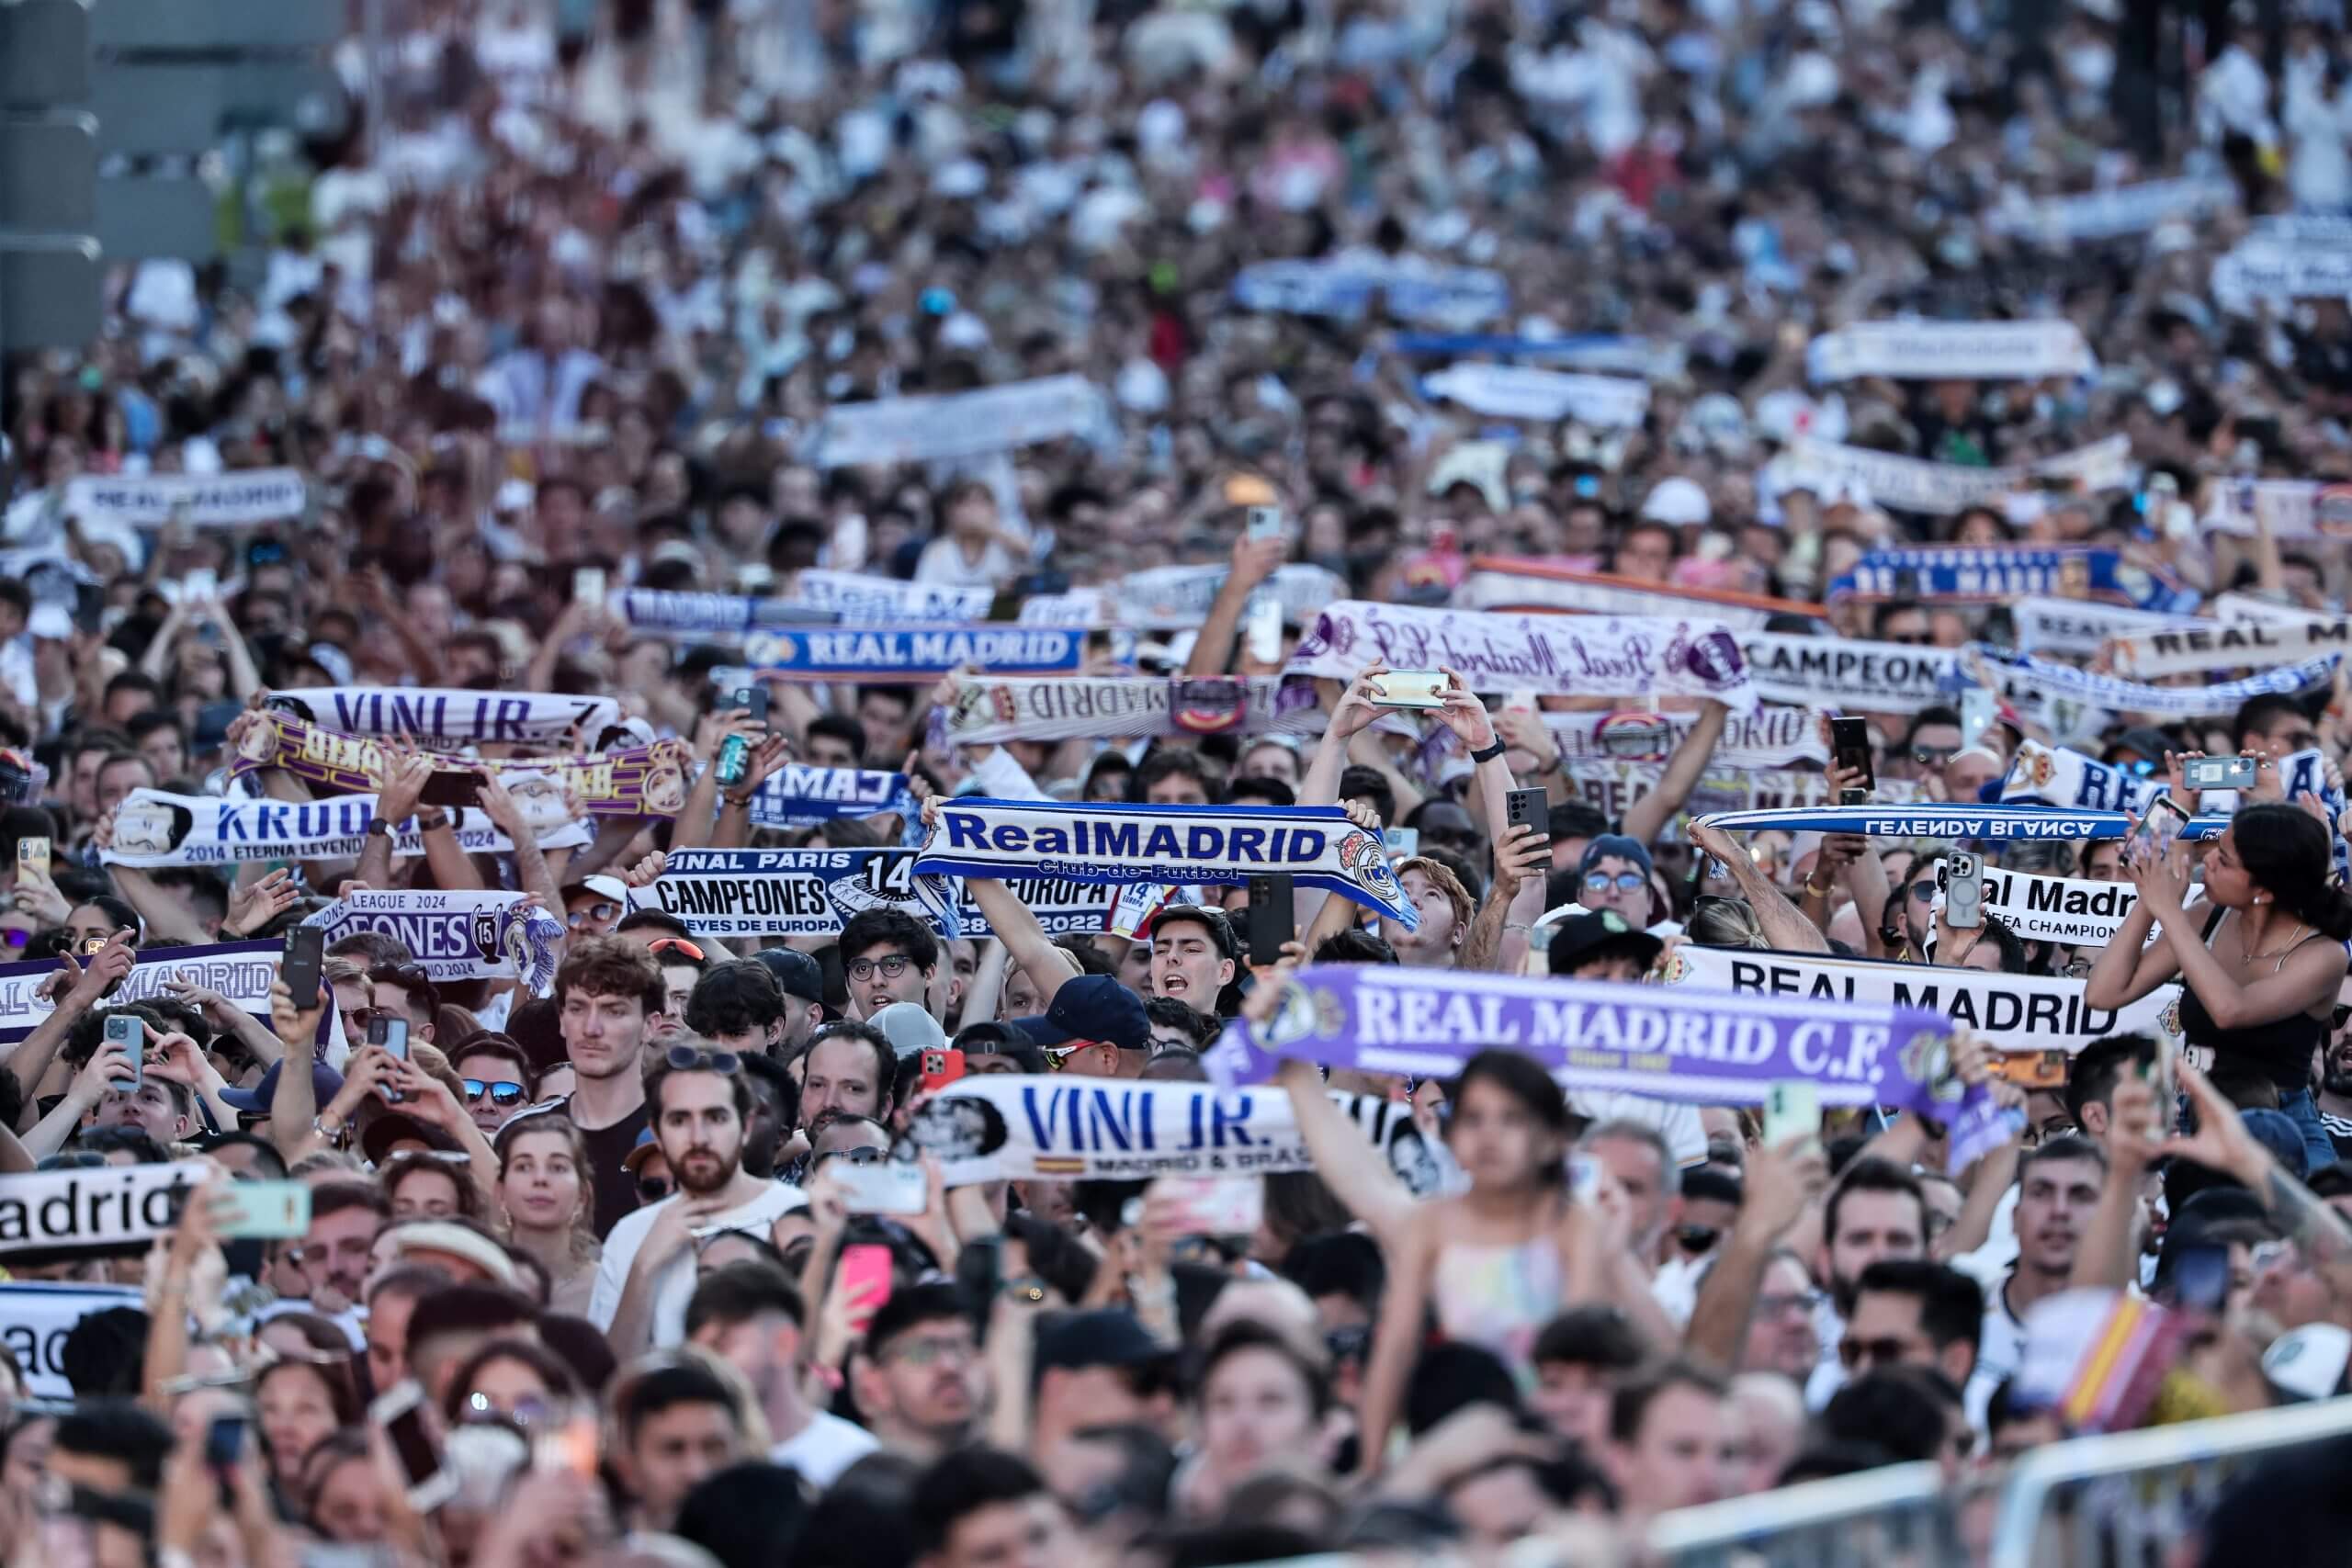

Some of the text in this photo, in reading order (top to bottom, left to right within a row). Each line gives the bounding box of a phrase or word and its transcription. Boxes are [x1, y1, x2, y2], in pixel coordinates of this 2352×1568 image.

[809, 632, 1070, 667] REAL MADRID
[2151, 627, 2278, 655] REAL
[334, 694, 447, 736] VINI
[473, 698, 540, 739] JR.
[1028, 684, 1169, 721] MADRID
[2074, 761, 2143, 814] RE
[186, 844, 226, 862] 2014
[234, 840, 296, 860] ETERNA
[300, 838, 363, 855] LEYEND
[944, 812, 1326, 863] RealMADRID
[758, 852, 852, 869] PARIS
[866, 854, 913, 894] 14
[1037, 859, 1239, 880] Club de Futbol
[352, 895, 406, 908] LEAGUE
[416, 896, 447, 908] 2024
[656, 878, 826, 916] CAMPEONES
[1128, 882, 1148, 900] 14
[1937, 865, 2138, 917] al Madr
[323, 914, 468, 957] PEONES
[476, 921, 492, 945] 15
[684, 919, 842, 932] EYES DE EUROPA
[2030, 919, 2119, 939] CHAMPION
[109, 961, 276, 1005] MADRID
[425, 963, 475, 977] NIO 2024
[1731, 961, 2120, 1036] REAL MADRID
[1353, 985, 1521, 1046] REAL
[1530, 999, 1777, 1066] MADRID
[1023, 1086, 1157, 1152] VINI
[1176, 1092, 1273, 1150] JR.
